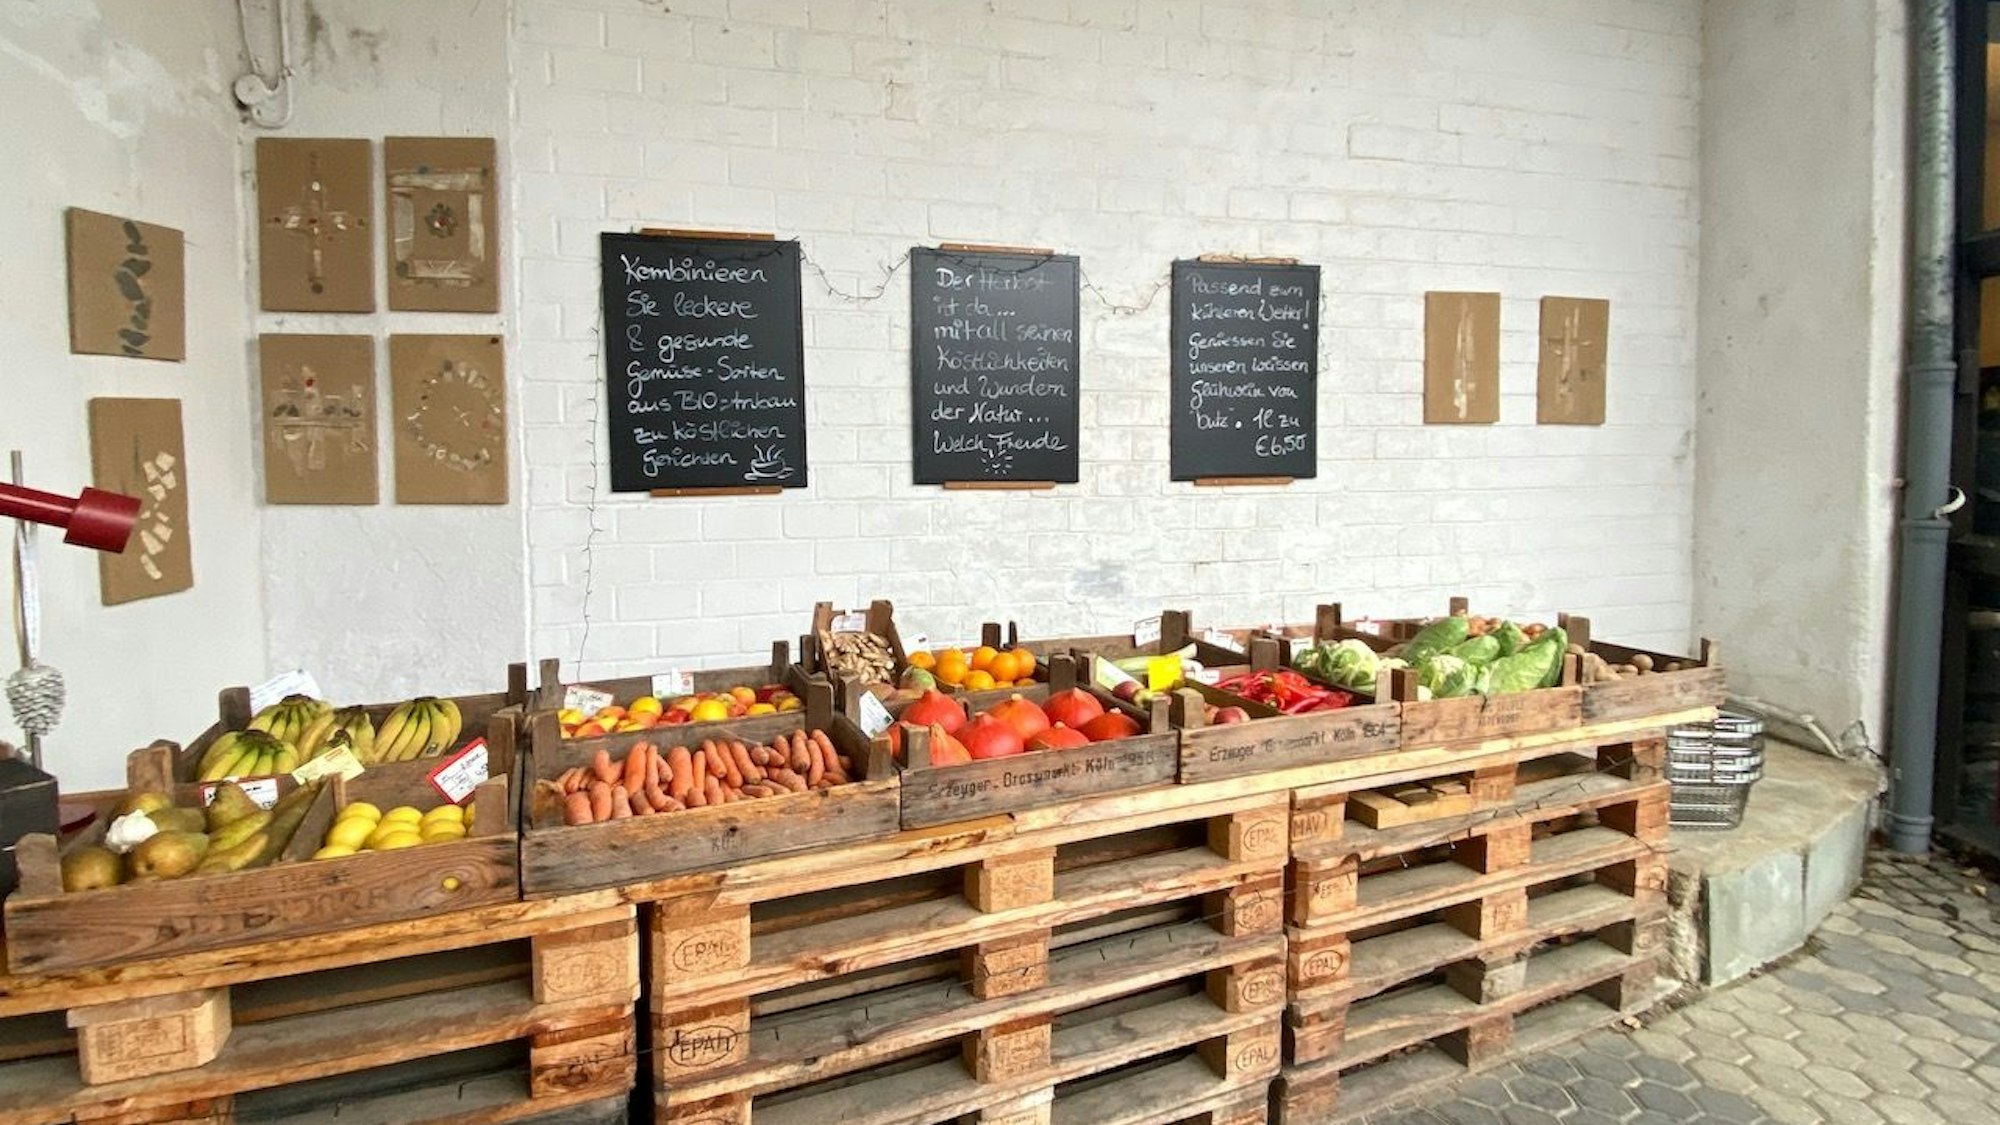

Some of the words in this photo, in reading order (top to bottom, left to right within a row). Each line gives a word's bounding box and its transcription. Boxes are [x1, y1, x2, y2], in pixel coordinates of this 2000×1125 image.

[620, 254, 767, 285] Kombinieren
[935, 267, 973, 290] Der
[978, 266, 1053, 291] Herbst
[1189, 275, 1262, 297] Passend
[1269, 284, 1303, 297] zum
[626, 290, 660, 317] Sie
[674, 291, 758, 318] leckere
[933, 295, 959, 316] ist
[626, 324, 645, 351] &
[657, 327, 754, 363] gesunde
[1015, 324, 1073, 343] seinen
[1272, 330, 1296, 349] Sie
[936, 344, 1069, 373] Köstlichkeiten
[1189, 360, 1247, 375] unseren
[933, 377, 970, 396] und
[977, 375, 1067, 400] Wundern
[1268, 386, 1299, 400] von
[627, 400, 672, 414] aus
[930, 401, 965, 421] der
[1278, 414, 1300, 428] zu
[633, 426, 668, 445] zu
[672, 420, 786, 440] köstlichen
[988, 430, 1068, 452] Freude
[642, 447, 737, 477] Gerichten
[1309, 955, 1337, 976] EPAL
